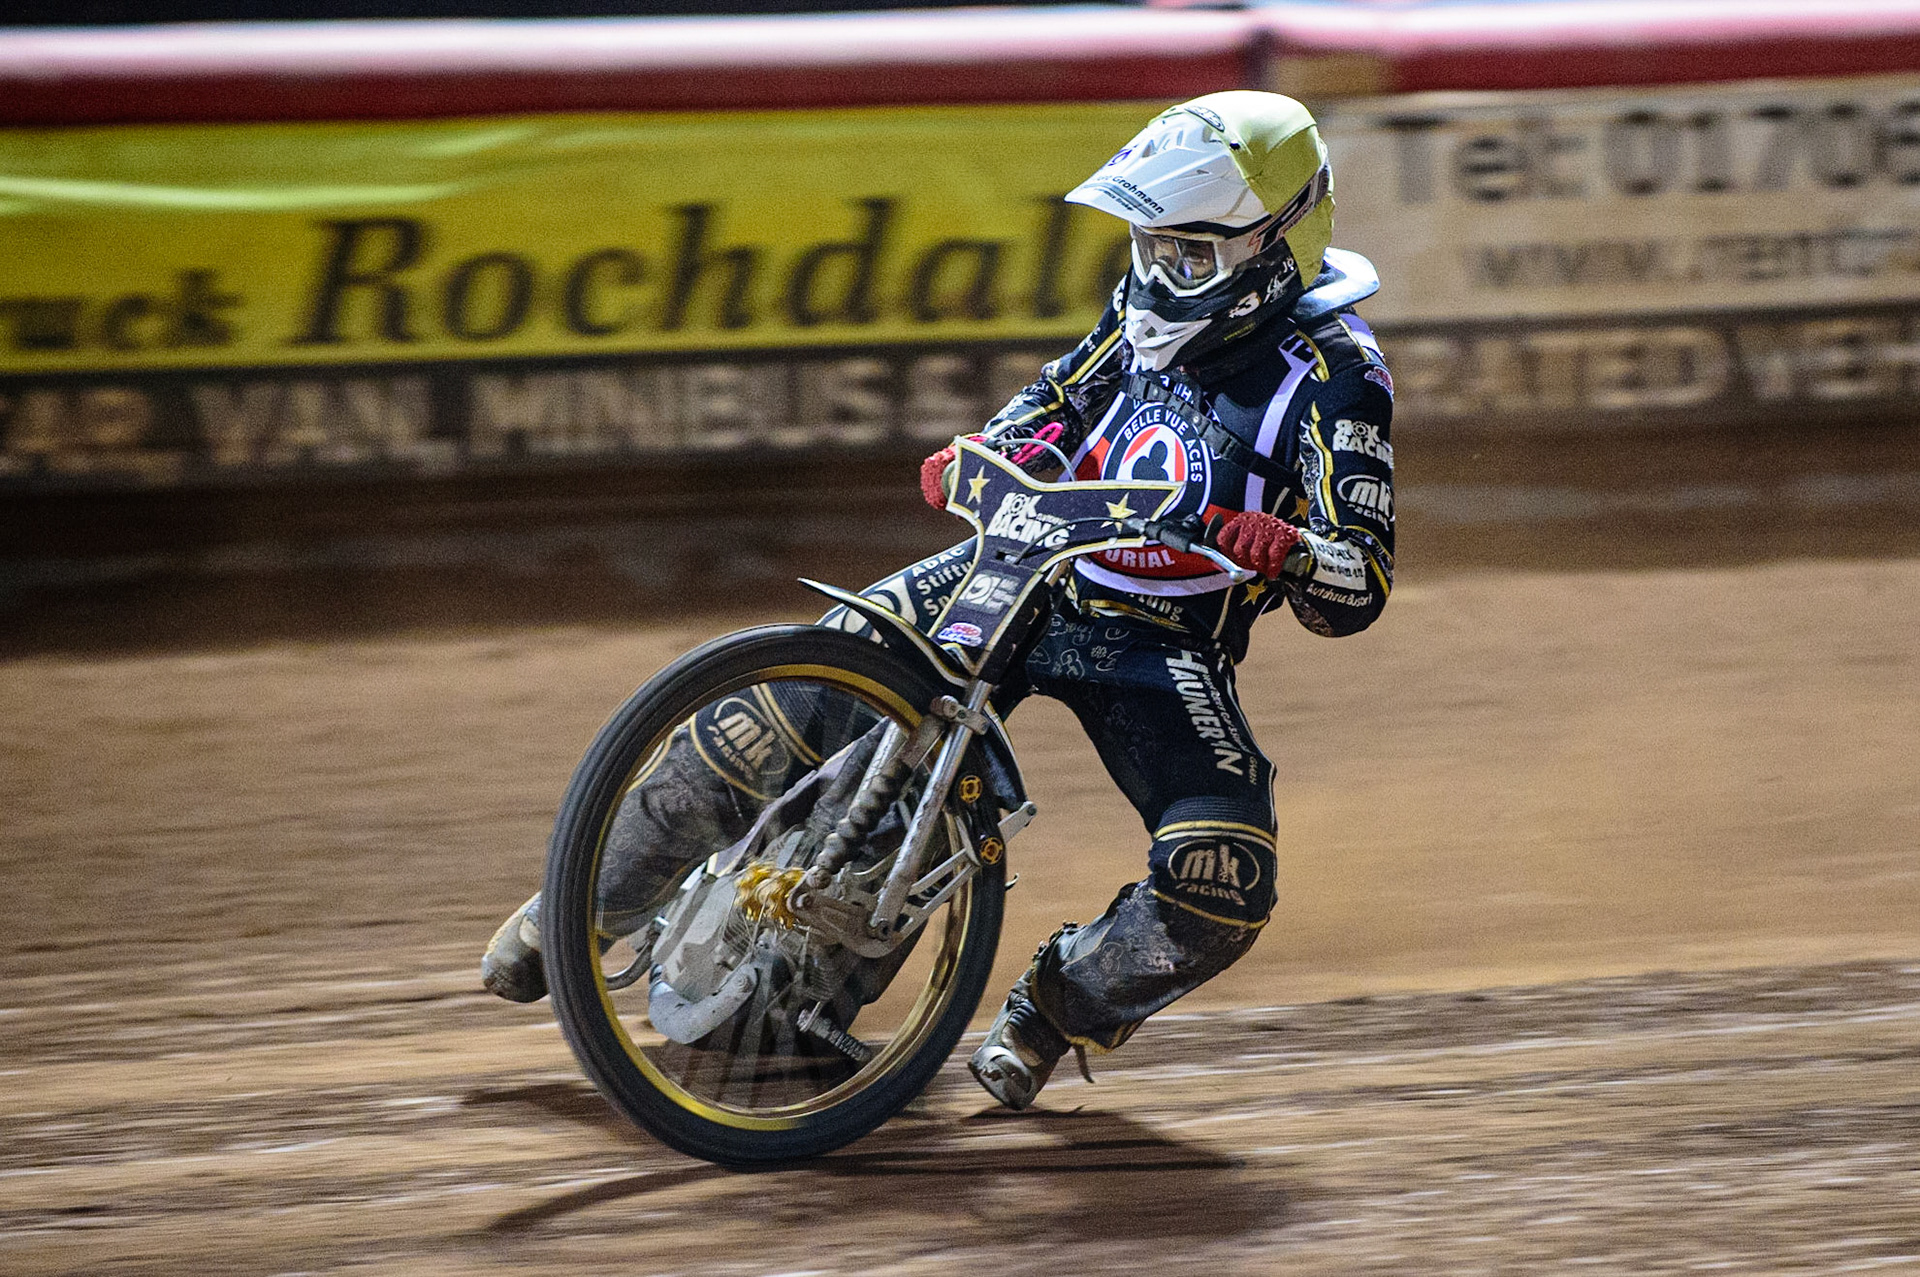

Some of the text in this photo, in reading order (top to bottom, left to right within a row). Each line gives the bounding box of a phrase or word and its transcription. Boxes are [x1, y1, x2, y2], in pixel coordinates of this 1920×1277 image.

[1112, 175, 1165, 214] Grohmann
[1123, 408, 1204, 484] BELLE VUE ACES
[985, 511, 1071, 551] RACING
[912, 546, 966, 578] ADAC
[717, 711, 777, 770] mk
[1179, 843, 1242, 889] mk
[1175, 881, 1246, 906] racing
